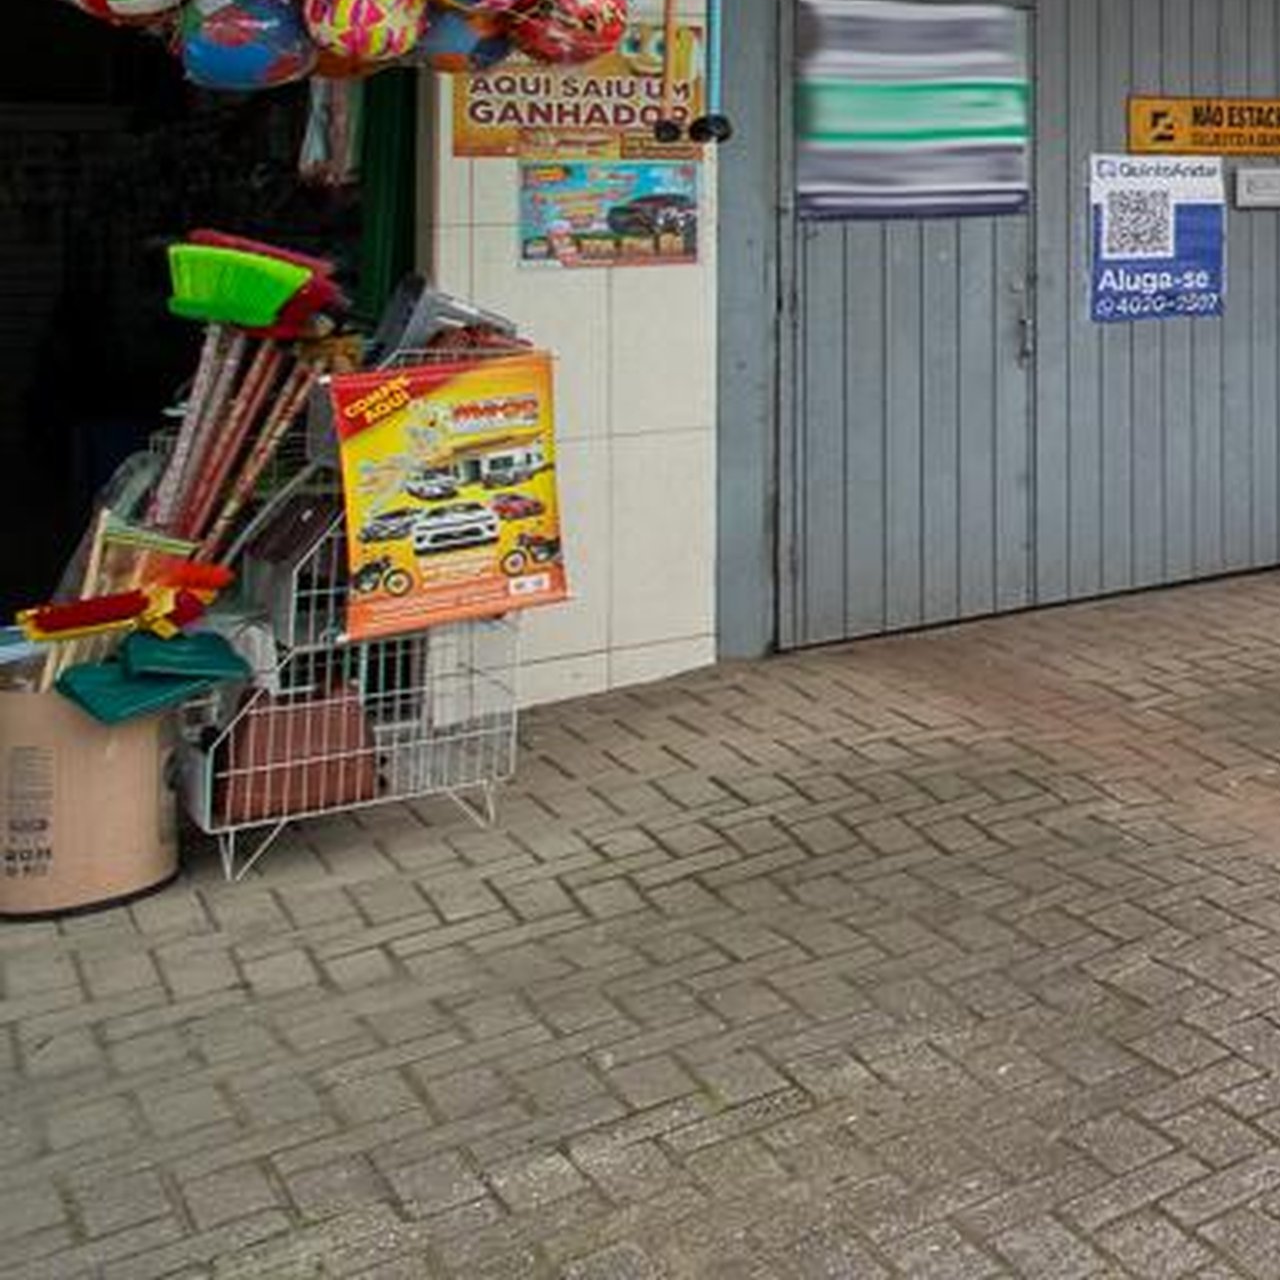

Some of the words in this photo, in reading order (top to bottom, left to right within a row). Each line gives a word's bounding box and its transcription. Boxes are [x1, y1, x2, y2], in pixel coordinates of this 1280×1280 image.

[469, 76, 550, 96] AQUI
[562, 76, 636, 99] SAIU
[468, 100, 690, 126] GANHADOR
